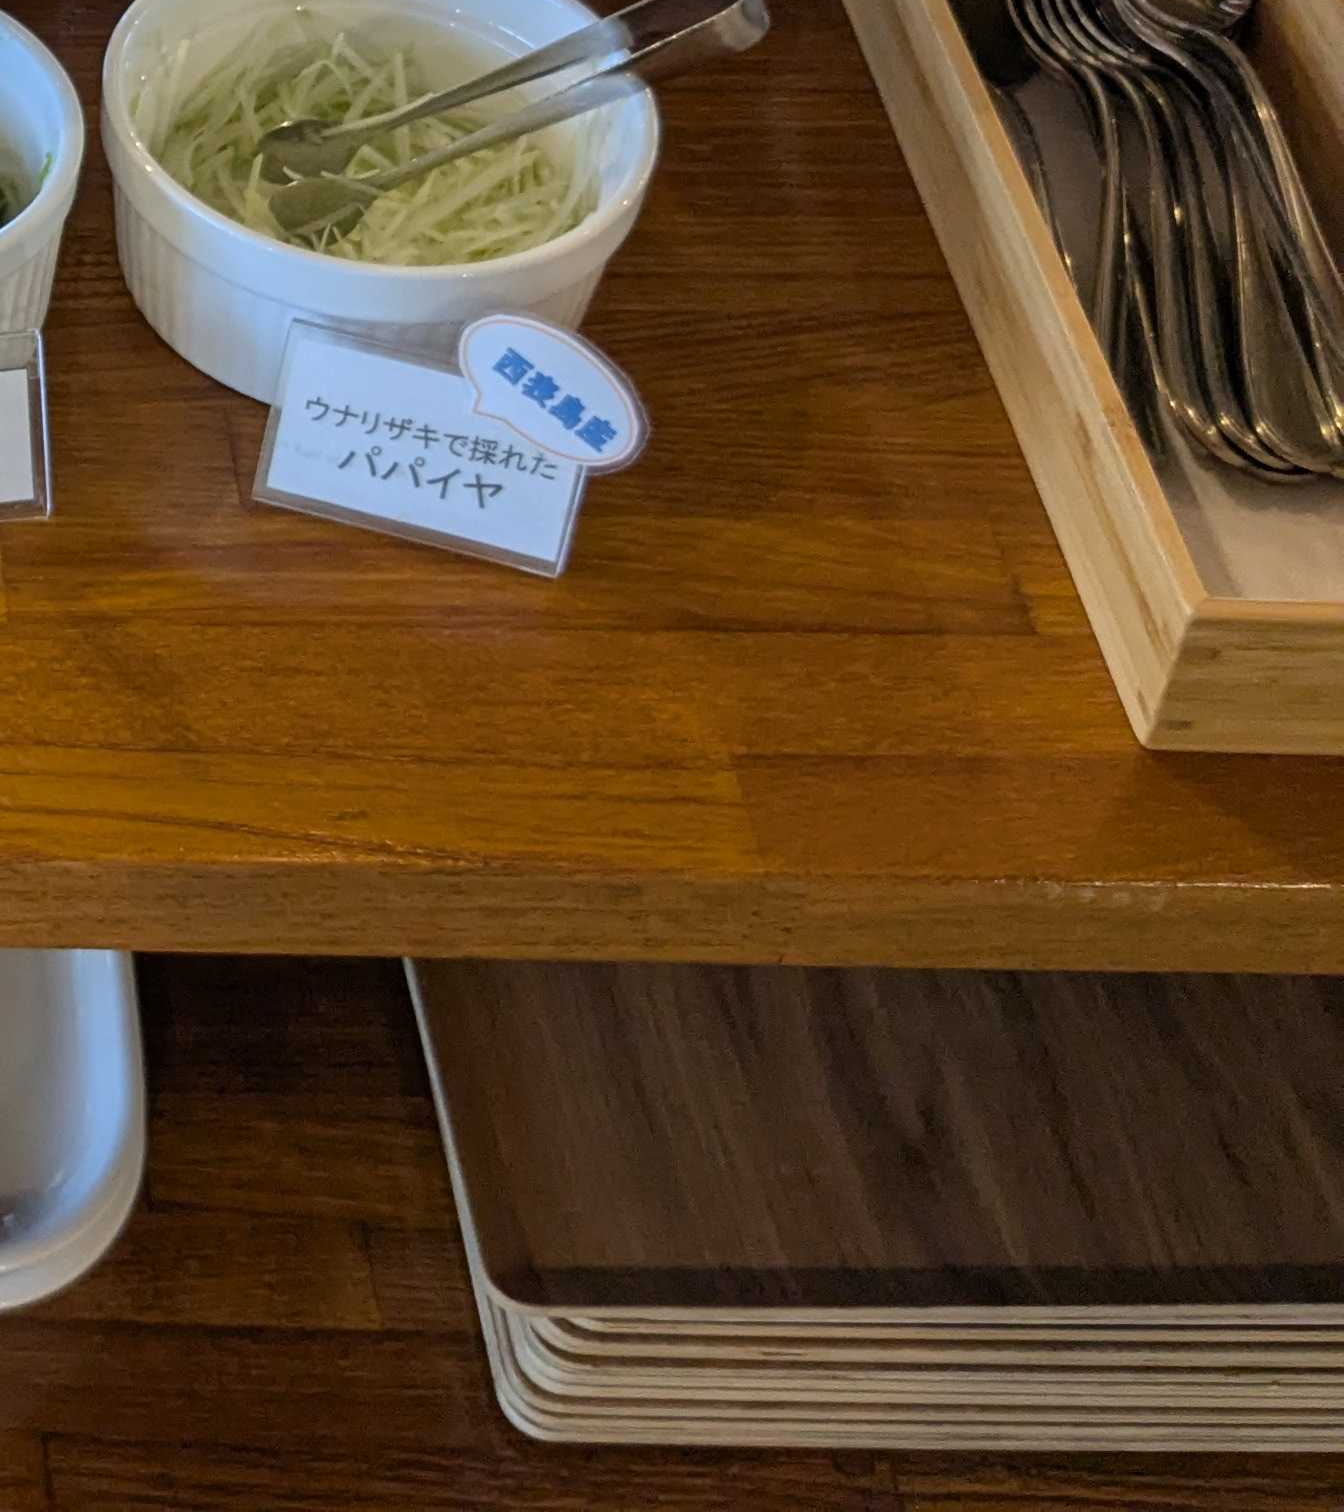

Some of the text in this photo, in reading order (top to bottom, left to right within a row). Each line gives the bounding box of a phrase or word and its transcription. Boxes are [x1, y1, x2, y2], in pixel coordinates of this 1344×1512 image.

[304, 396, 559, 481] ウナリザキで採れた
[492, 347, 618, 453] 西表島産
[338, 445, 504, 509] パパイヤ
